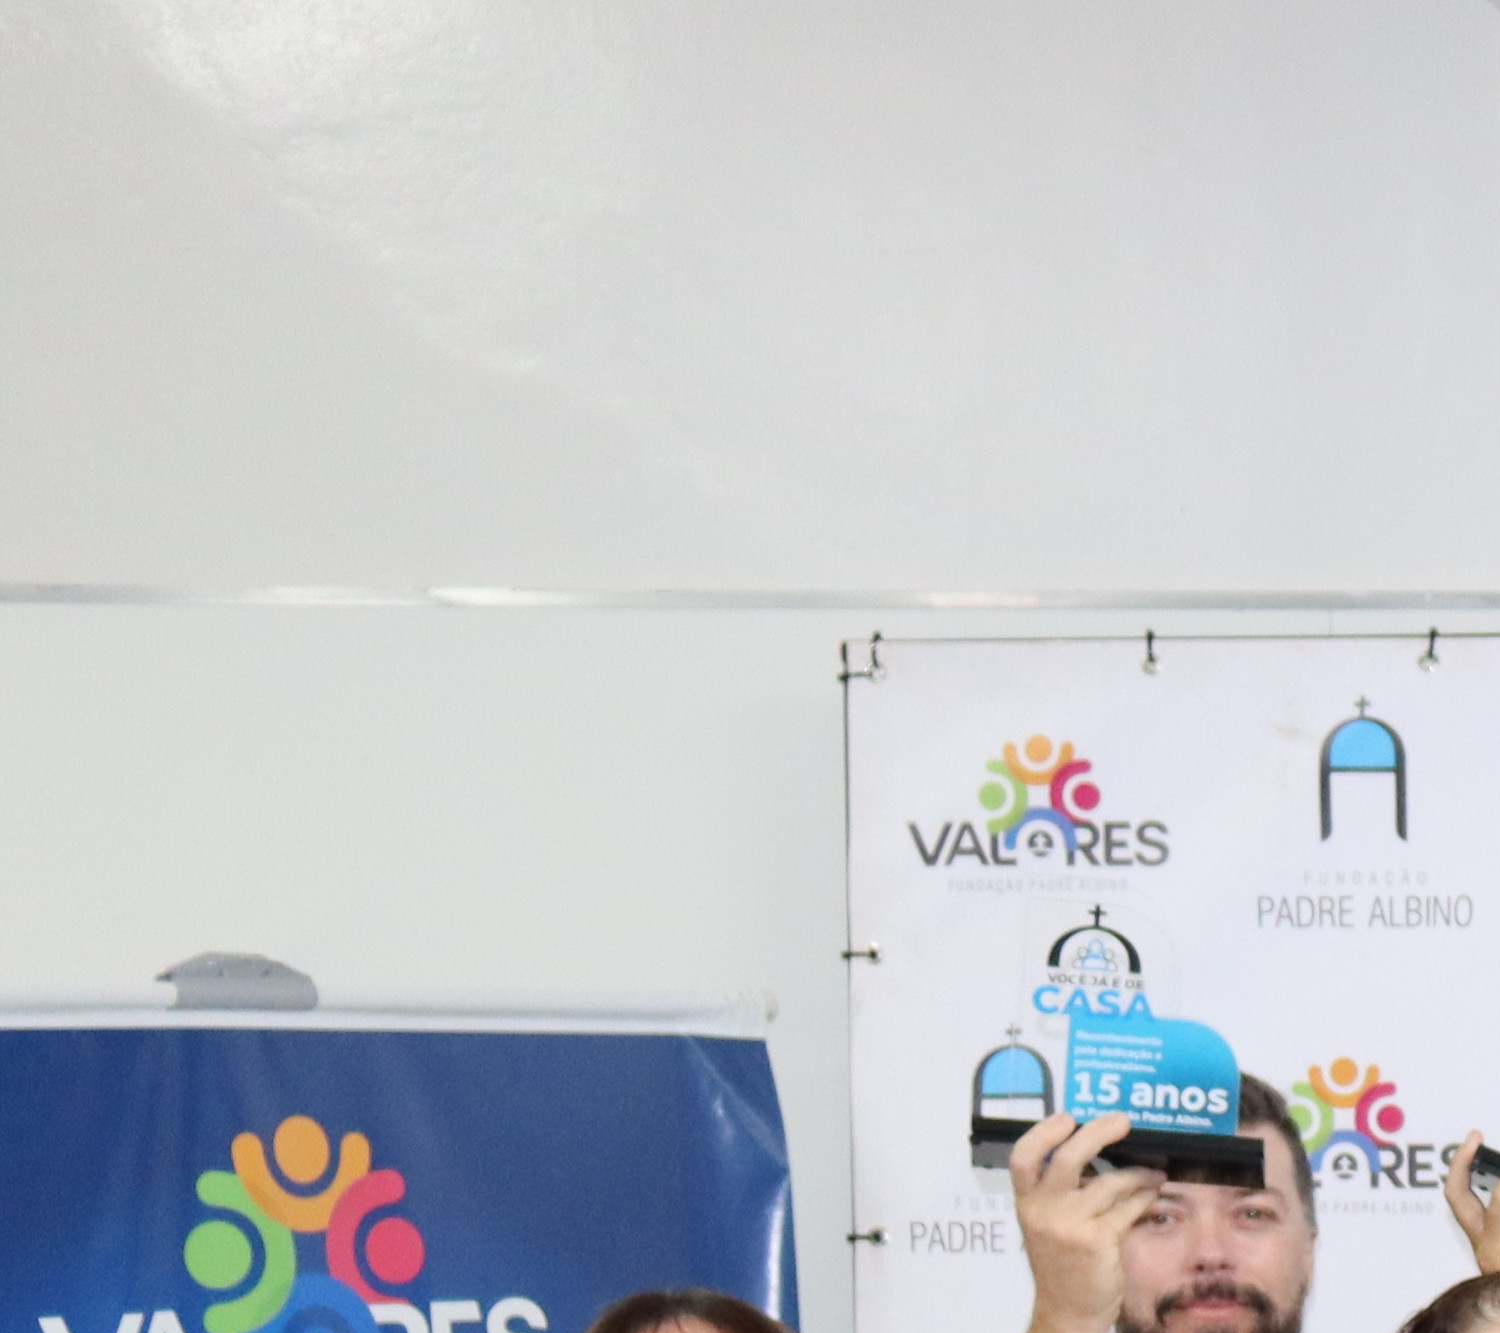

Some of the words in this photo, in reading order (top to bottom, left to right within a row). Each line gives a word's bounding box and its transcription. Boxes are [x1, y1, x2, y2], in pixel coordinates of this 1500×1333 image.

[1257, 896, 1354, 927] PADRE
[1368, 895, 1474, 928] ALBINO
[1032, 984, 1156, 1020] CASA
[1073, 1072, 1122, 1104] 15
[1129, 1080, 1229, 1114] anos
[910, 1223, 1004, 1252] PADRE
